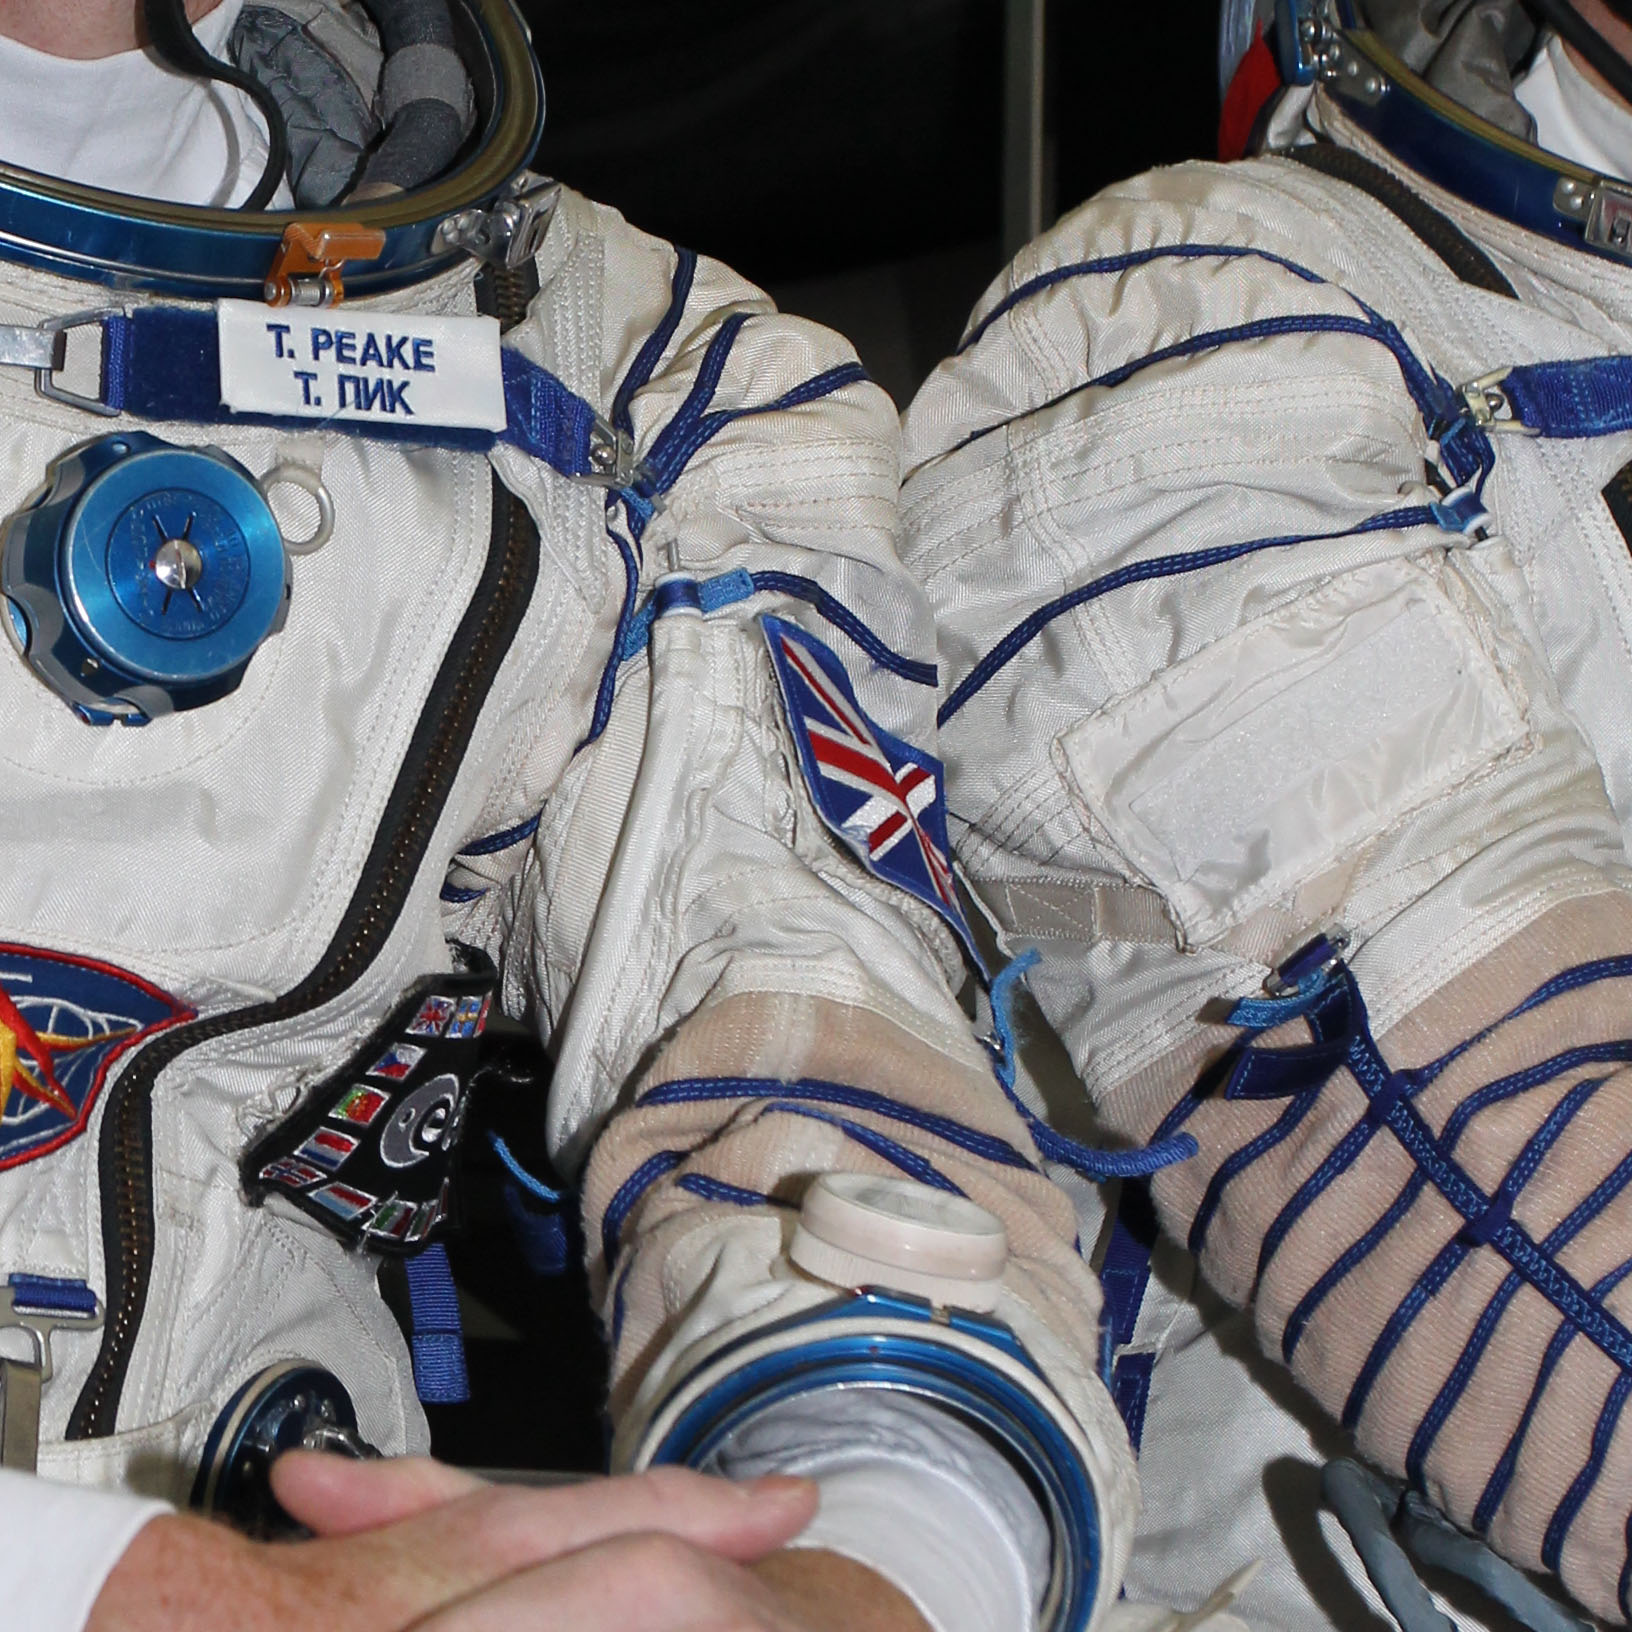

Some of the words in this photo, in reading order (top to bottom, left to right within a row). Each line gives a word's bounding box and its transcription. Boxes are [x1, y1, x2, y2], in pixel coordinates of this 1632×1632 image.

[266, 323, 295, 358] T.
[310, 327, 436, 372] PEAKE
[293, 370, 322, 406] Т.
[337, 373, 415, 415] ПИК
